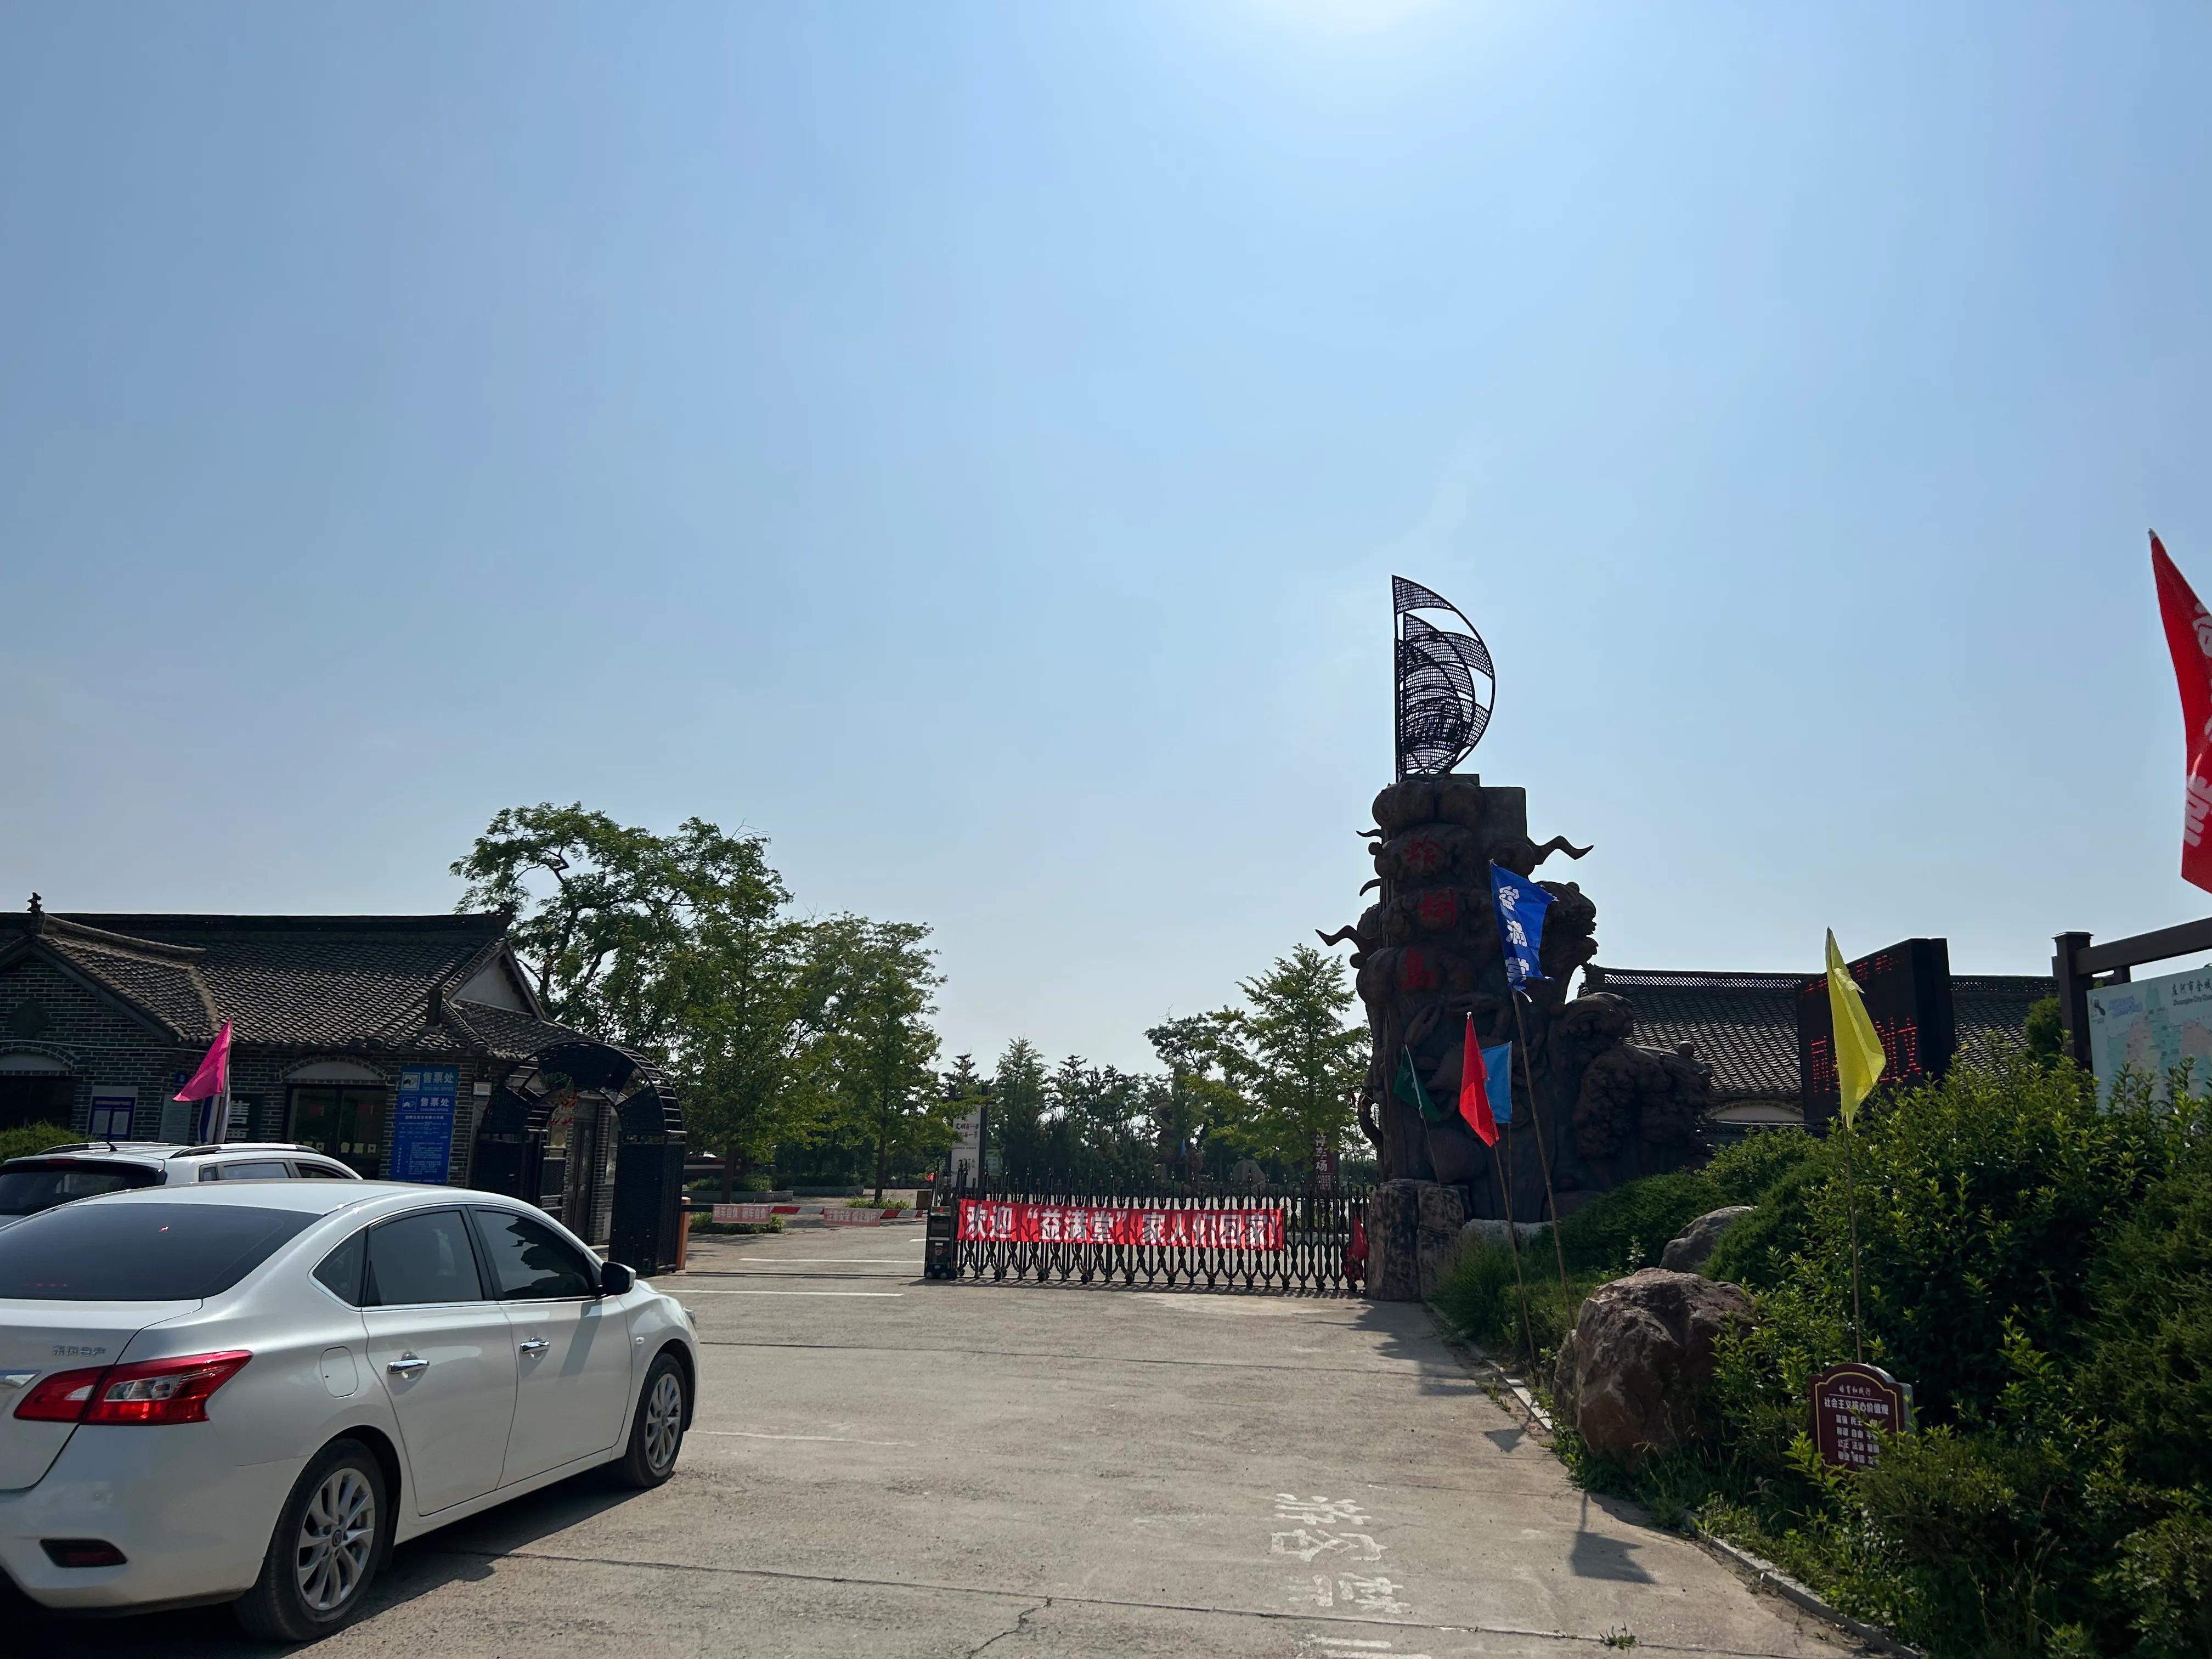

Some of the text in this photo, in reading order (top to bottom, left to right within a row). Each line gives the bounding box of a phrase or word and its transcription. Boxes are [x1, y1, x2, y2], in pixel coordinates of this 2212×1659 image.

[423, 1071, 454, 1084] 售票处
[420, 1097, 450, 1107] 售票处
[1824, 1397, 1889, 1414] 社会主义核心价值观
